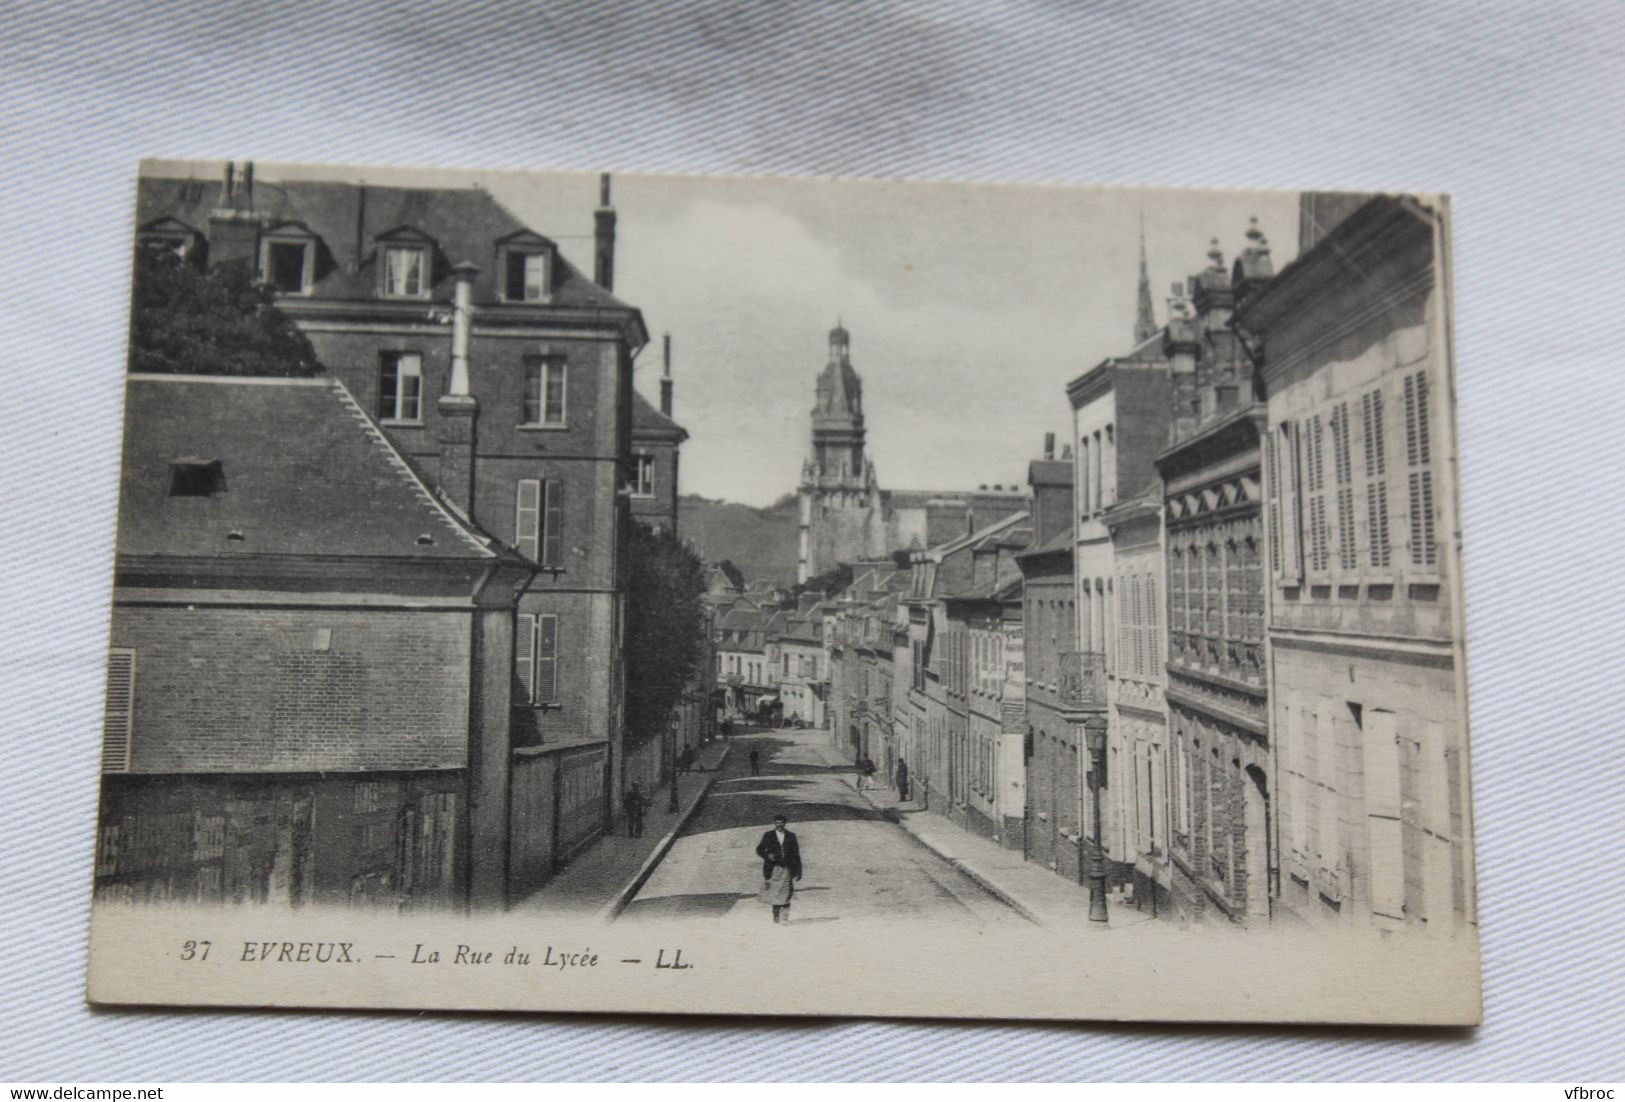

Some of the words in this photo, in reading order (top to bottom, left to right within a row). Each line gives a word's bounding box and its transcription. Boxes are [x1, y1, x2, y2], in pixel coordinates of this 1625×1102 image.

[180, 939, 213, 962] 37
[239, 941, 362, 964] EVREUX.
[411, 943, 441, 965] La
[453, 944, 494, 966] Rue
[504, 945, 531, 966] du
[543, 946, 600, 972] Lycée
